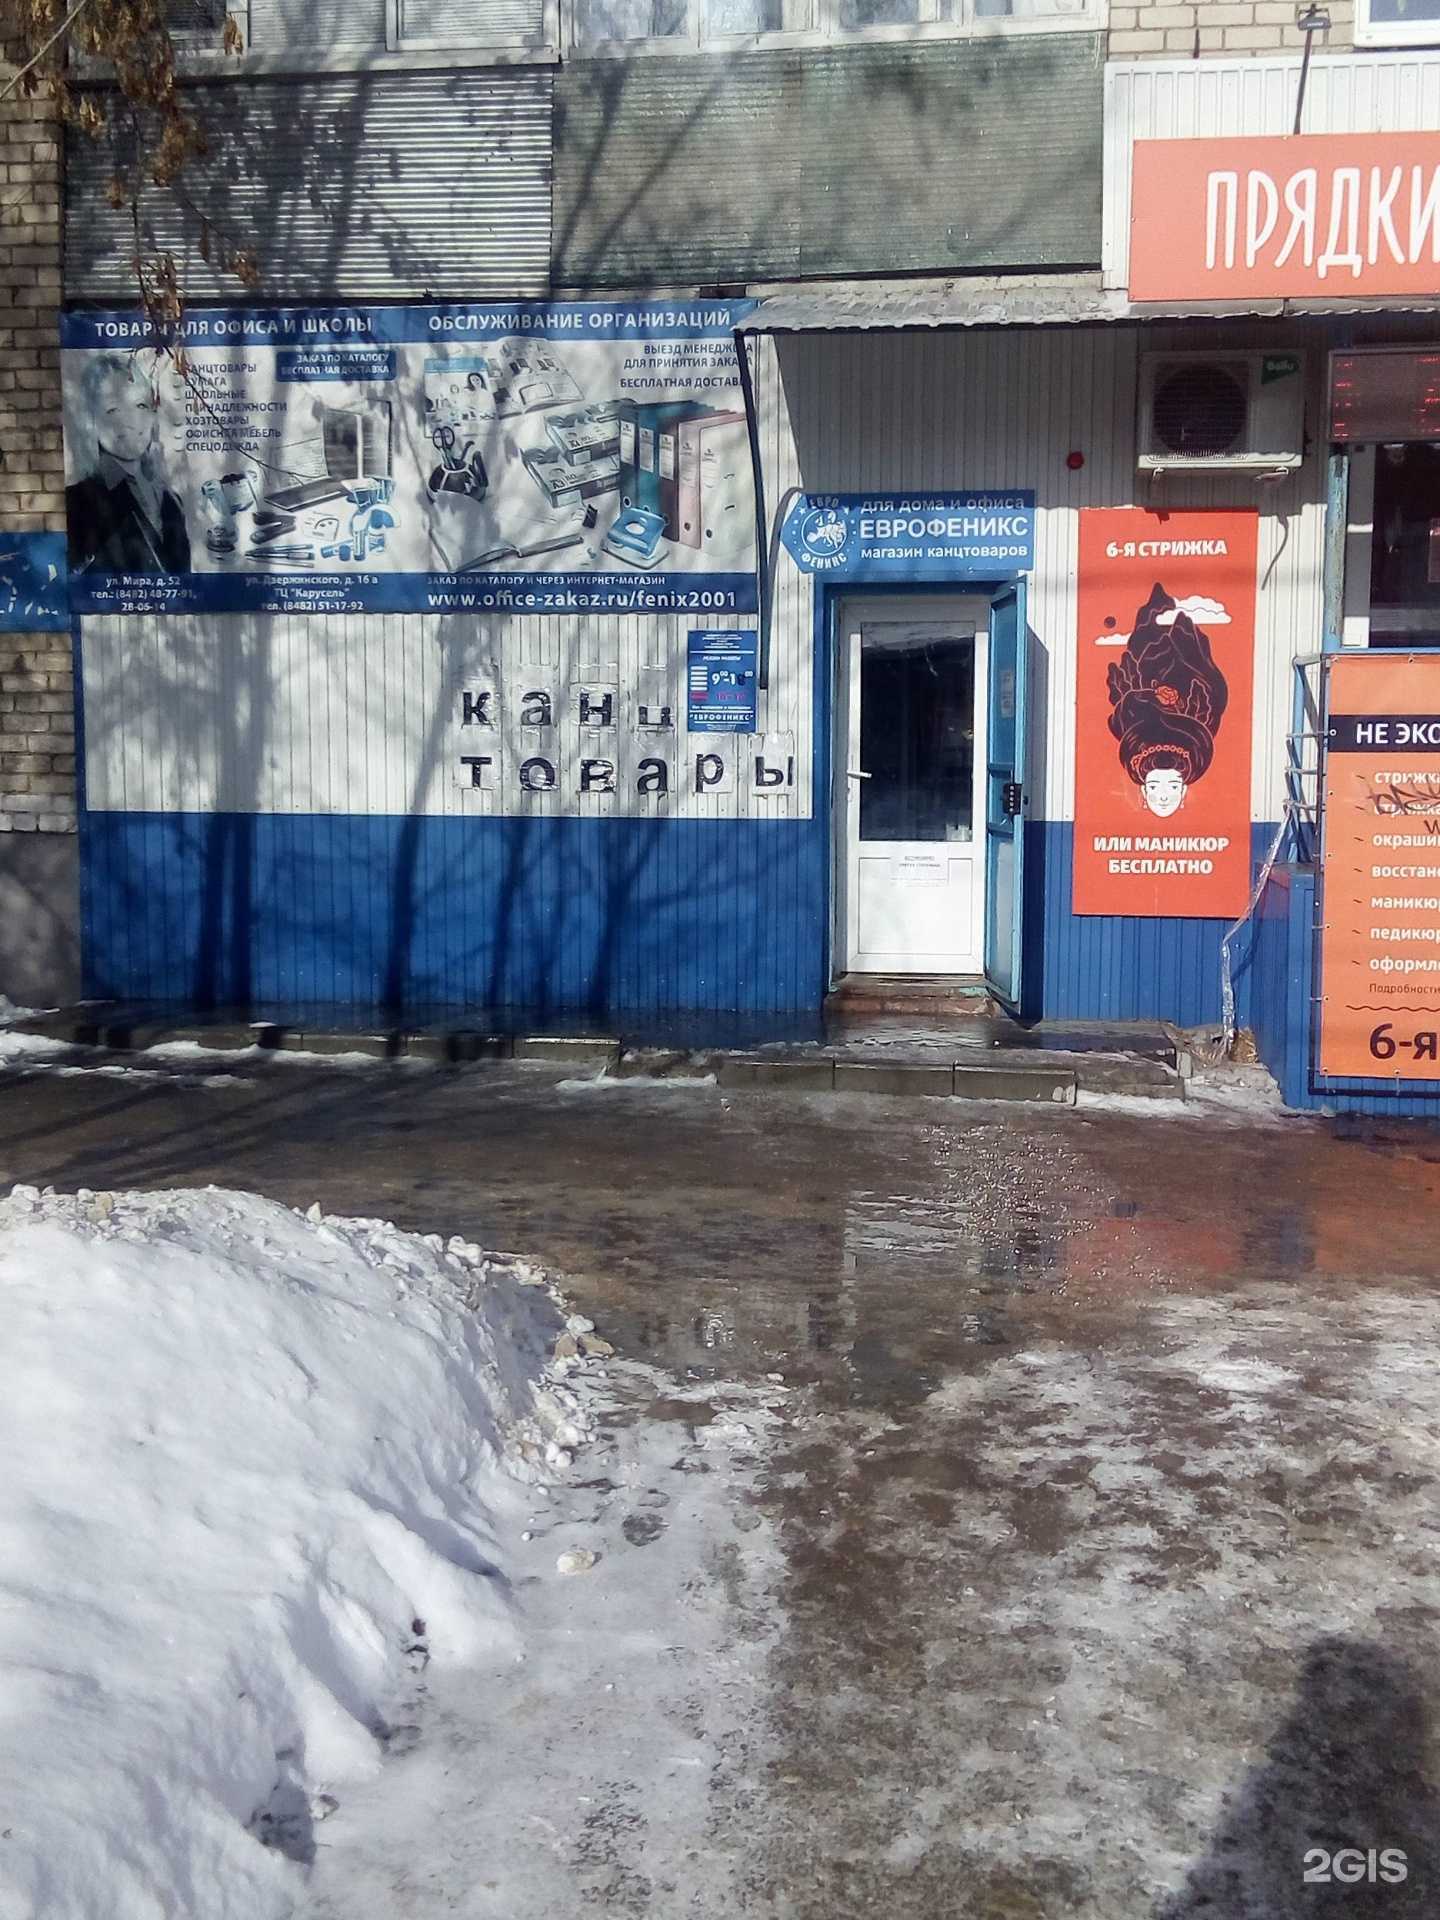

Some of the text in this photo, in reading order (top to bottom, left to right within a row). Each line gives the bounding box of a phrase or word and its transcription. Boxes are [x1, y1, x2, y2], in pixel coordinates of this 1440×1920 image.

[1205, 165, 1440, 279] ПРЯДКИ
[428, 308, 730, 331] ОБСЛУЖИВАНИЕ ОРГАНИЗАЦИЙ
[174, 320, 208, 338] ДЛЯ
[214, 319, 278, 335] ОФИСА
[284, 318, 296, 333] И
[302, 317, 371, 333] ШКОЛЫ
[644, 343, 753, 355] ВЫЕЗД МЕНЕДЖА
[624, 356, 752, 369] ДЛЯ ПРИНЯТИЯ ЗАКАА
[620, 377, 742, 388] БЕСПЛАТНАЯ ДОСТАВ
[185, 402, 287, 413] ПИНАДЛЕЖНОСТИ
[186, 416, 249, 425] ХОЗТОВАРЫ
[186, 442, 259, 452] СПЕЦОДДА
[860, 495, 1024, 513] для дома и офиса
[860, 517, 1028, 539] ЕВРОФЕНИКС
[861, 545, 1028, 560] магазин канцтоваров
[1106, 540, 1227, 557] 6-Я СТРИЖКА
[801, 552, 847, 569] ФЕНИКС
[428, 576, 457, 585] ЗАКАЗ
[461, 577, 473, 585] ПО
[475, 576, 524, 585] КАТАЛОГУ
[536, 576, 564, 585] ЧЕРЕЗ
[567, 576, 665, 585] ИНТЕРНЕТ-МАГАЗИН
[318, 601, 364, 611] 51-17-92
[428, 590, 736, 607] www.office-zakaz.ru/fenix2001
[1356, 723, 1389, 744] НЕ
[461, 753, 794, 794] товары
[1094, 837, 1229, 851] ИЛИ МАНИКЮР
[1108, 859, 1213, 874] БЕСПЛАТНО
[1372, 866, 1440, 878] восстан
[1371, 896, 1440, 911] маникю
[1370, 956, 1440, 974] оформл
